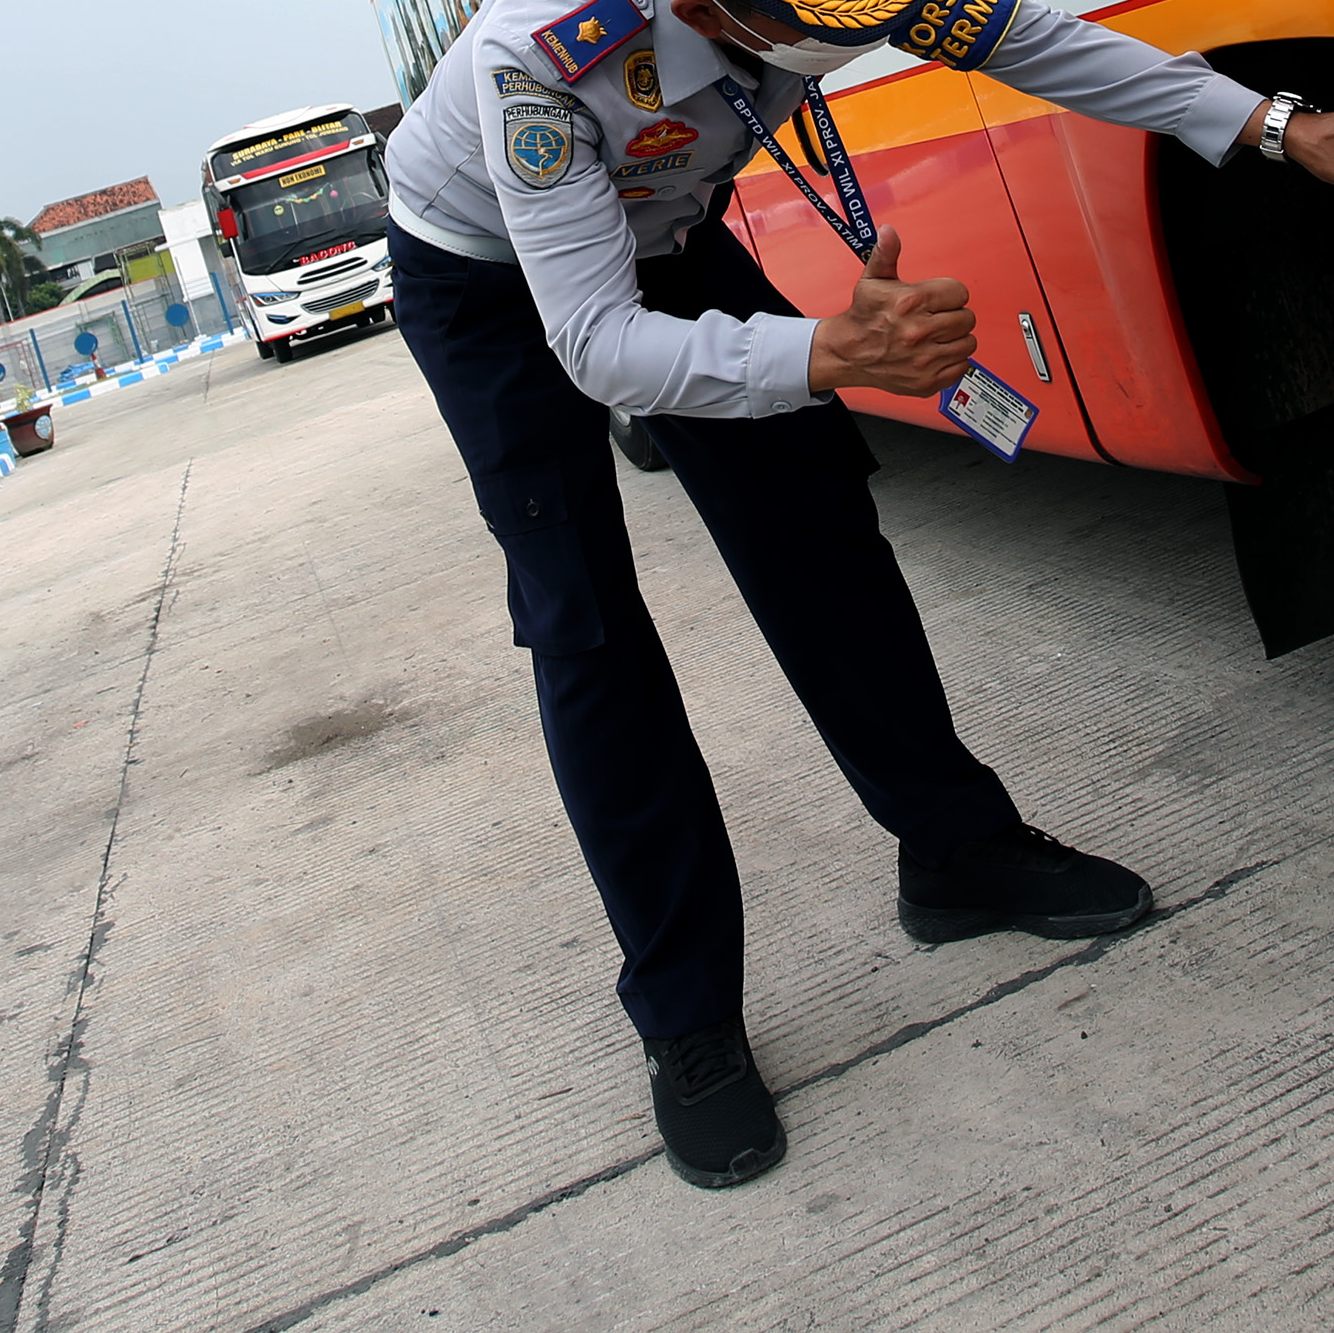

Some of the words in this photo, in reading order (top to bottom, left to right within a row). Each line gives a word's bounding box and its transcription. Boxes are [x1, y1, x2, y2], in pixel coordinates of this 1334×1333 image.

[541, 29, 579, 74] KEMENHUB
[805, 75, 819, 100] JAT
[507, 105, 569, 120] PERHUBUNGAN
[619, 154, 689, 177] VERIE
[830, 151, 845, 167] XI
[282, 176, 295, 185] NON
[295, 167, 322, 181] EKONOMI
[733, 98, 764, 135] BPTD
[762, 136, 780, 160] WIL
[782, 162, 795, 175] XI
[794, 177, 827, 213] PROV.
[827, 215, 863, 249] JATIM
[838, 167, 856, 198] WIL
[848, 198, 872, 240] BPTD
[299, 241, 356, 265] BAGONG
